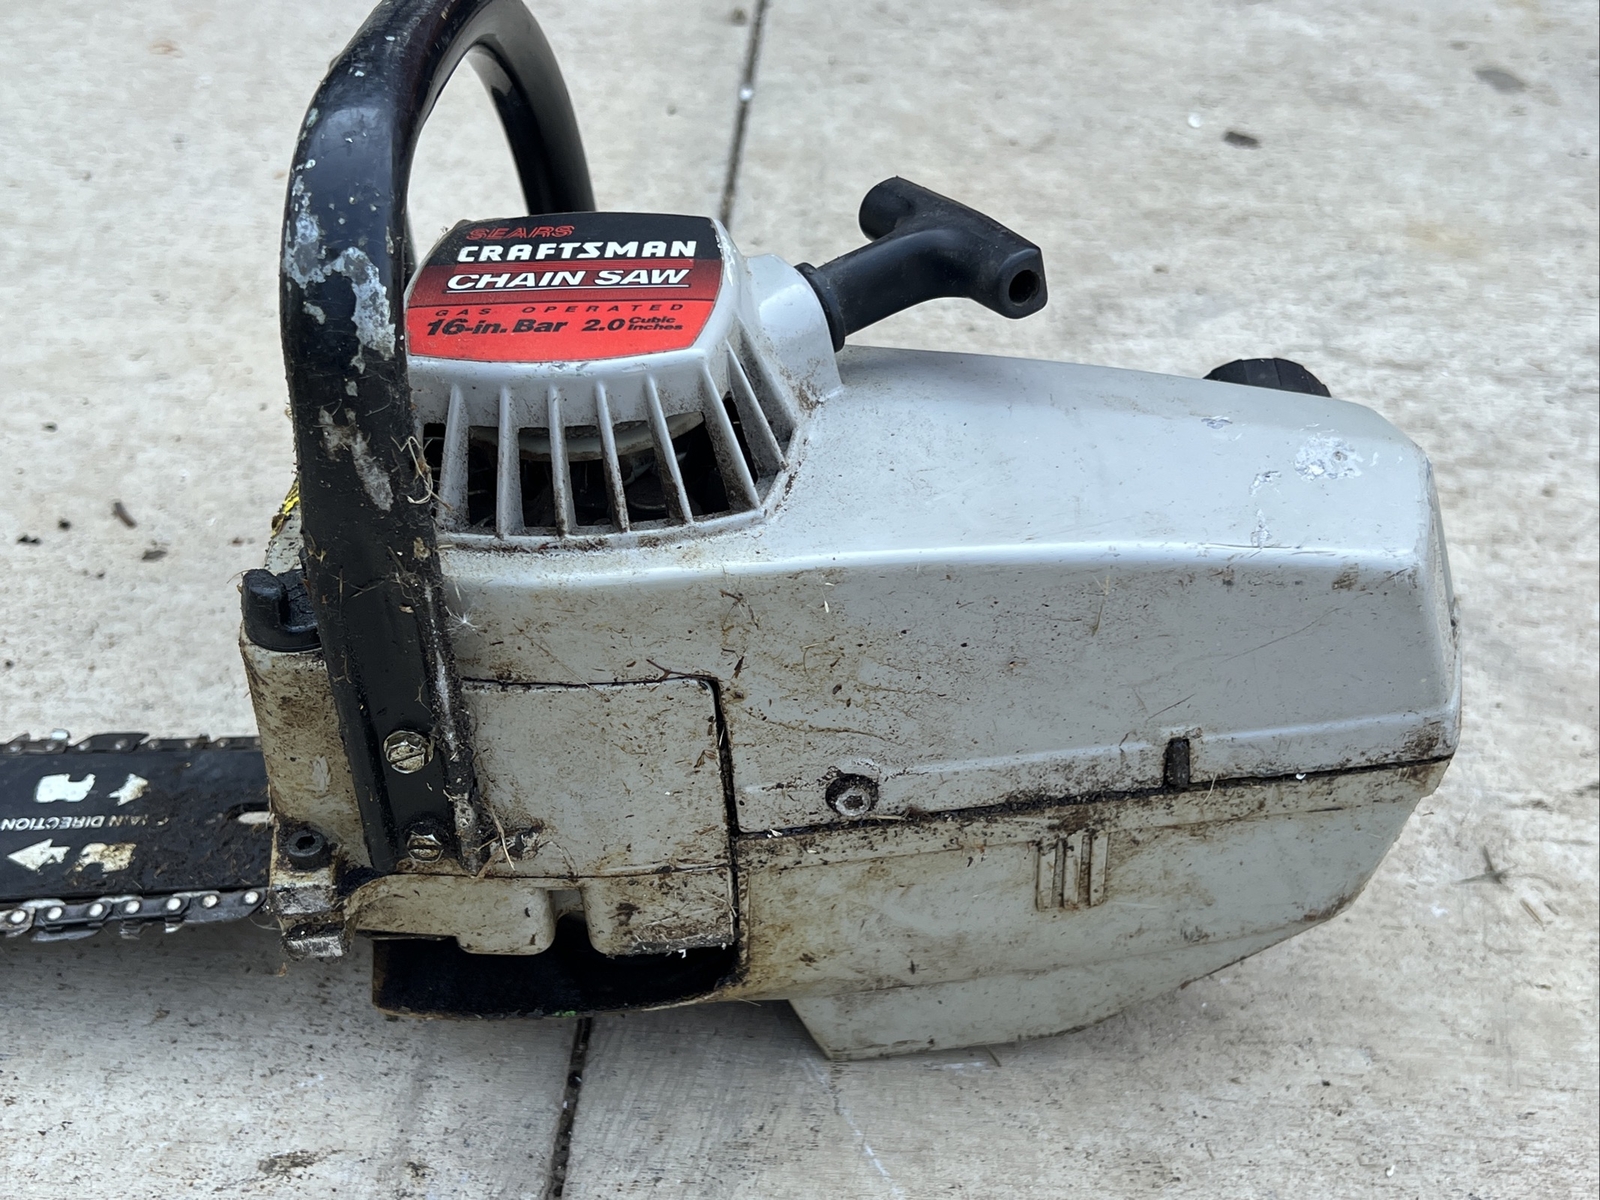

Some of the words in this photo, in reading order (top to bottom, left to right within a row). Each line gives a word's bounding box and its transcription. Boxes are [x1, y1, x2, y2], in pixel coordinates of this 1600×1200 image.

[466, 225, 575, 240] SEARS
[456, 240, 697, 263] CRAFTSMAN
[447, 269, 587, 290] CHAIN
[594, 269, 690, 286] SAW
[435, 308, 491, 317] GAS
[521, 303, 684, 314] OPERATED
[427, 318, 508, 336] 16-in.
[512, 318, 568, 333] Bar
[581, 318, 626, 332] 2.0
[628, 316, 676, 324] Cubic
[1, 815, 105, 831] DIRECTION
